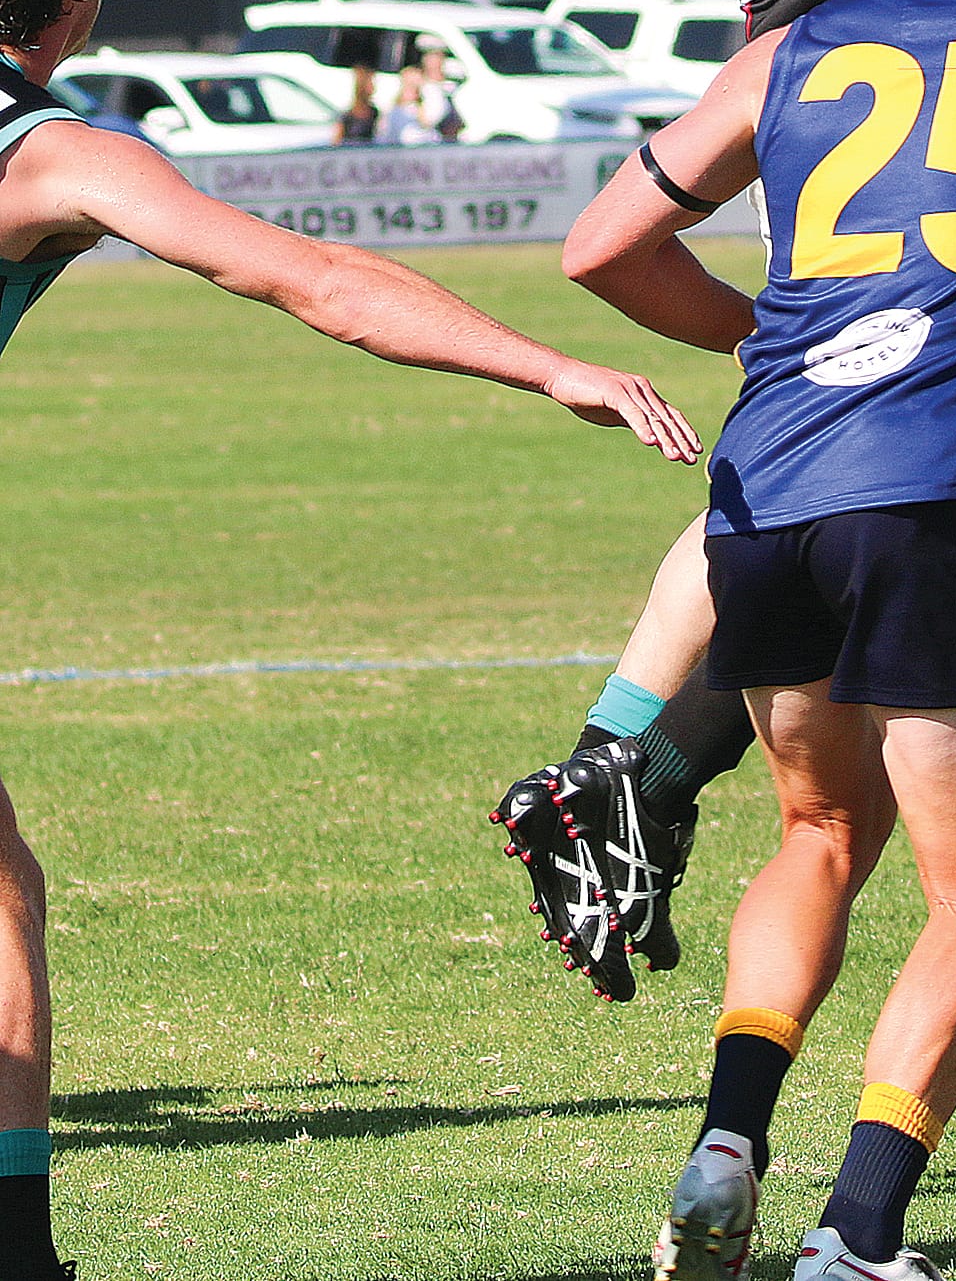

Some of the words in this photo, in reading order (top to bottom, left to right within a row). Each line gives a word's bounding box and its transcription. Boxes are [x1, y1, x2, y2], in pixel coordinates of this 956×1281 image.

[371, 202, 445, 234] 143
[463, 198, 539, 232] 197
[838, 345, 899, 370] HOTEL
